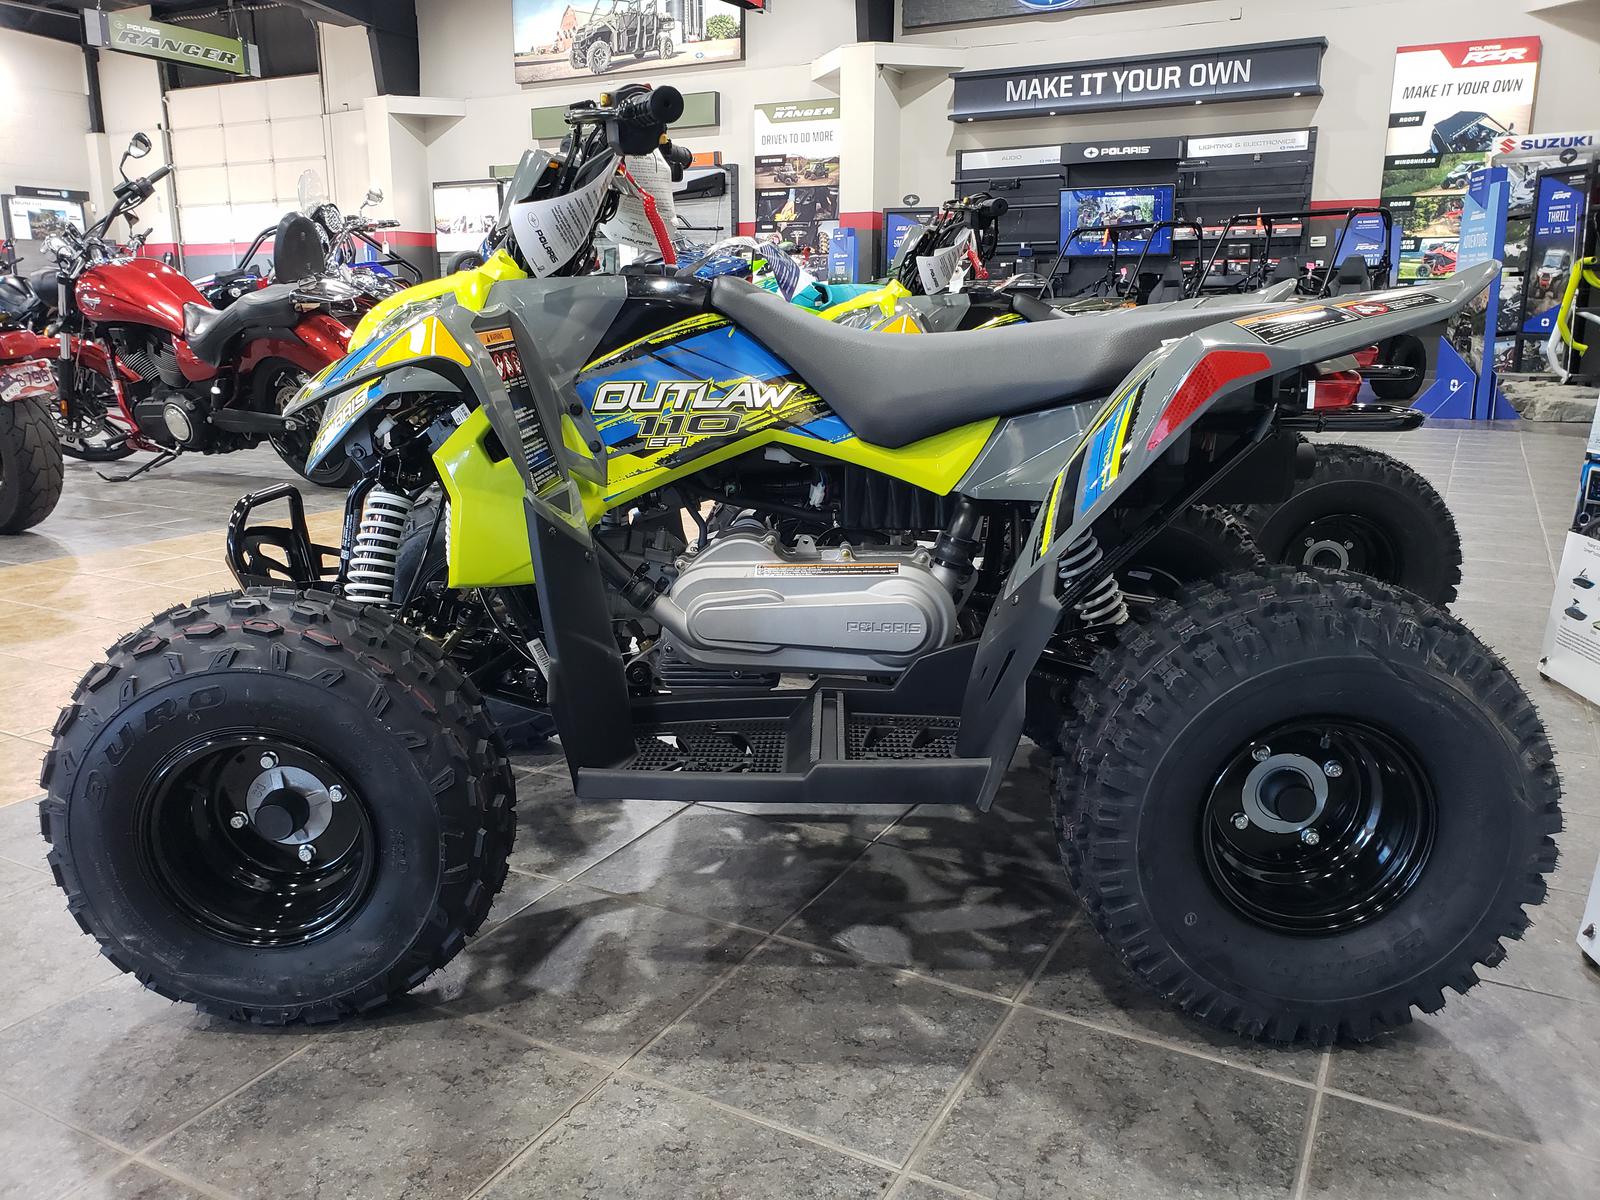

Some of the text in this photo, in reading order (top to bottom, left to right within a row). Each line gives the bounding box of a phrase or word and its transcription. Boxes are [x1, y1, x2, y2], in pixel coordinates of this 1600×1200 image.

[126, 24, 160, 34] POLARIS
[118, 31, 239, 65] RANGER
[1461, 48, 1528, 65] RZR
[1006, 59, 1252, 102] MAKE IT YOUR OWN
[1402, 78, 1524, 100] MAKE IT YOUR OWN
[772, 107, 835, 119] RANGER
[762, 130, 834, 146] DRIVEN TO DO MORE
[1198, 142, 1232, 150] LIGHTING
[1243, 138, 1296, 147] ELECTRONICS
[1520, 136, 1593, 150] SUZUKI
[1100, 146, 1150, 156] POLARIS
[1548, 210, 1570, 222] THRILL
[535, 229, 560, 264] POLARIS
[593, 382, 800, 412] OUTLAW
[636, 414, 742, 437] 110
[648, 438, 688, 446] EFI
[846, 622, 921, 634] POLARIS
